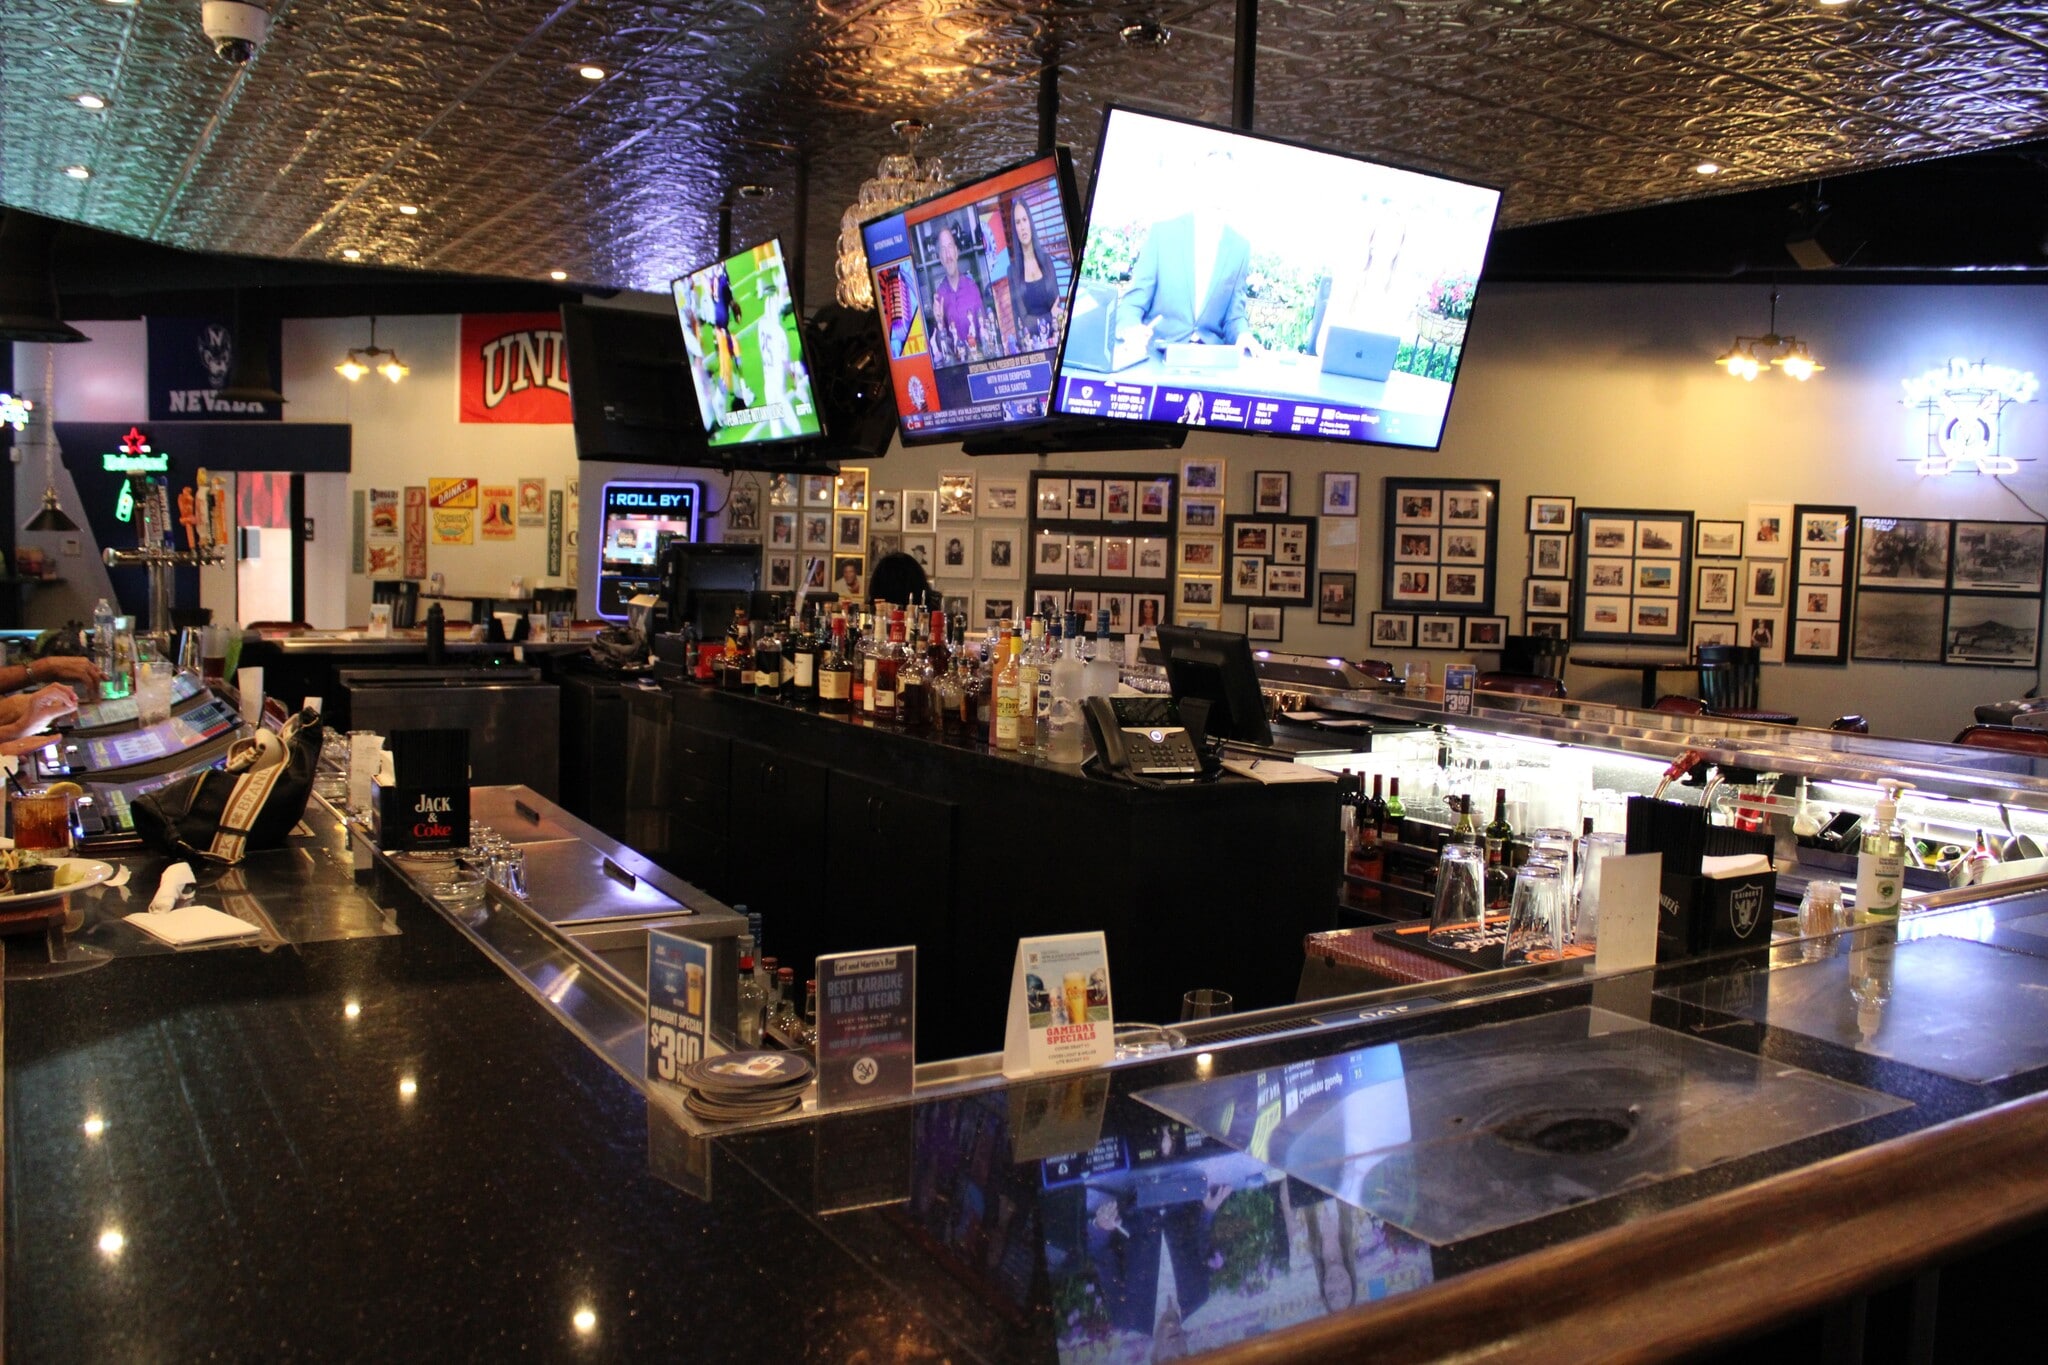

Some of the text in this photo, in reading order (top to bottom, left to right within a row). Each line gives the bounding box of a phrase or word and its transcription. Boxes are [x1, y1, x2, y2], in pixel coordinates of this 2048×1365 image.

[1009, 369, 1032, 381] DEMPSTER
[1010, 381, 1028, 391] SANTOS
[438, 480, 468, 506] DRINKS
[616, 494, 657, 507] ROLL
[660, 495, 680, 507] BY
[414, 793, 453, 813] JACK
[427, 812, 438, 823] &
[413, 823, 452, 838] Coke
[848, 961, 859, 970] and
[885, 956, 896, 967] Bar
[827, 972, 904, 998] BEST KARAOKE
[830, 990, 901, 1014] IN LAS VEGAS
[650, 1004, 703, 1035] DRAUGHT SPECIAL
[1046, 1023, 1095, 1037] GAMEDAY
[1046, 1031, 1097, 1045] SPECIALS
